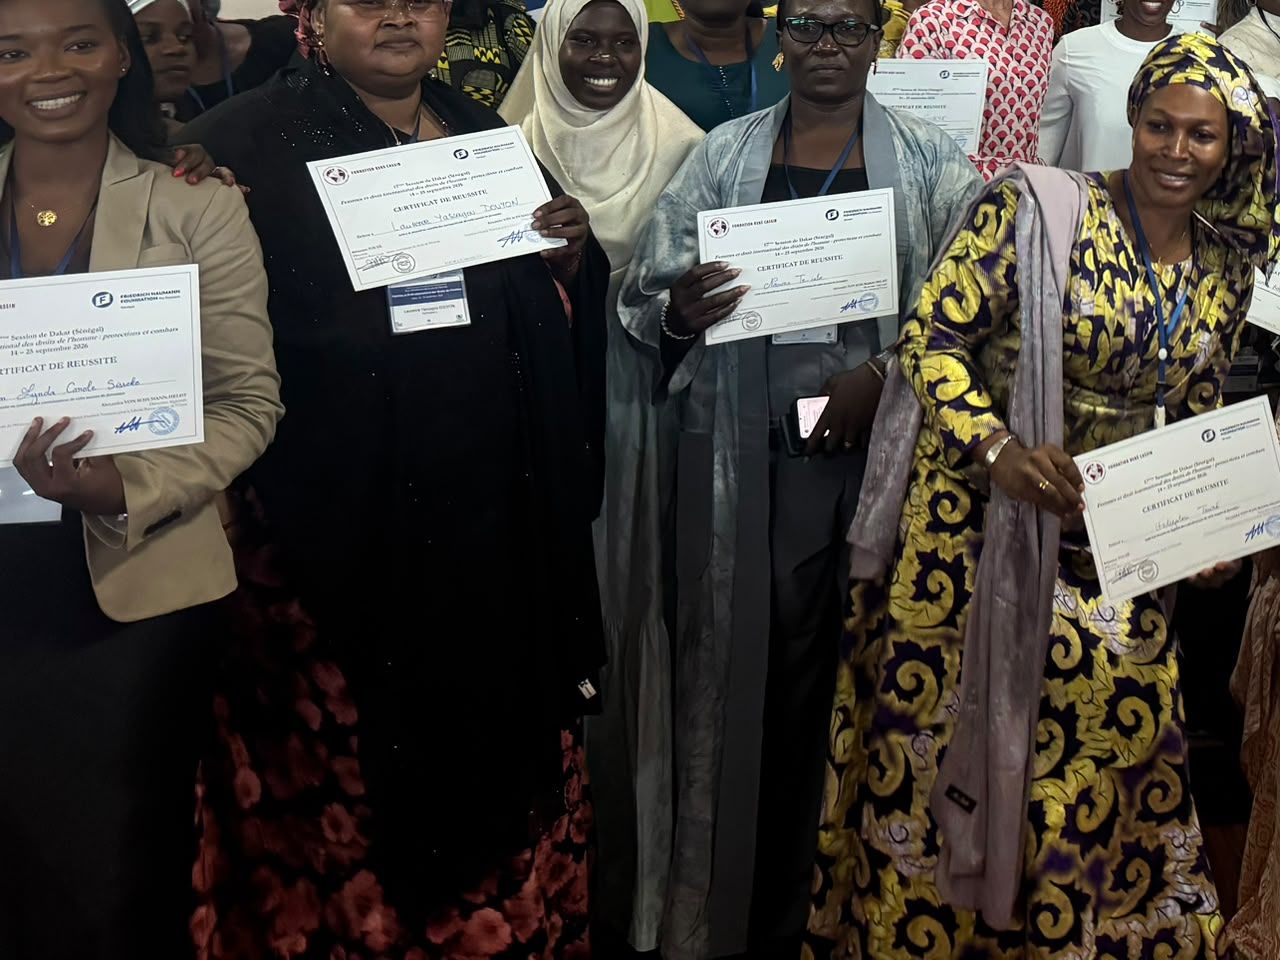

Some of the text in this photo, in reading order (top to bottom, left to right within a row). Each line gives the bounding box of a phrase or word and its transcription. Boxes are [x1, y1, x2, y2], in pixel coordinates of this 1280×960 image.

[392, 199, 439, 213] CERTIFICAT
[451, 189, 488, 201] REUSSITE
[756, 260, 797, 272] CERTIFICAT
[810, 254, 843, 264] REUSSITE
[49, 362, 64, 370] DE
[66, 356, 118, 368] REUSSITE
[66, 380, 97, 394] Carole
[1141, 478, 1229, 514] CERTIFICAT DE REUSSITE
